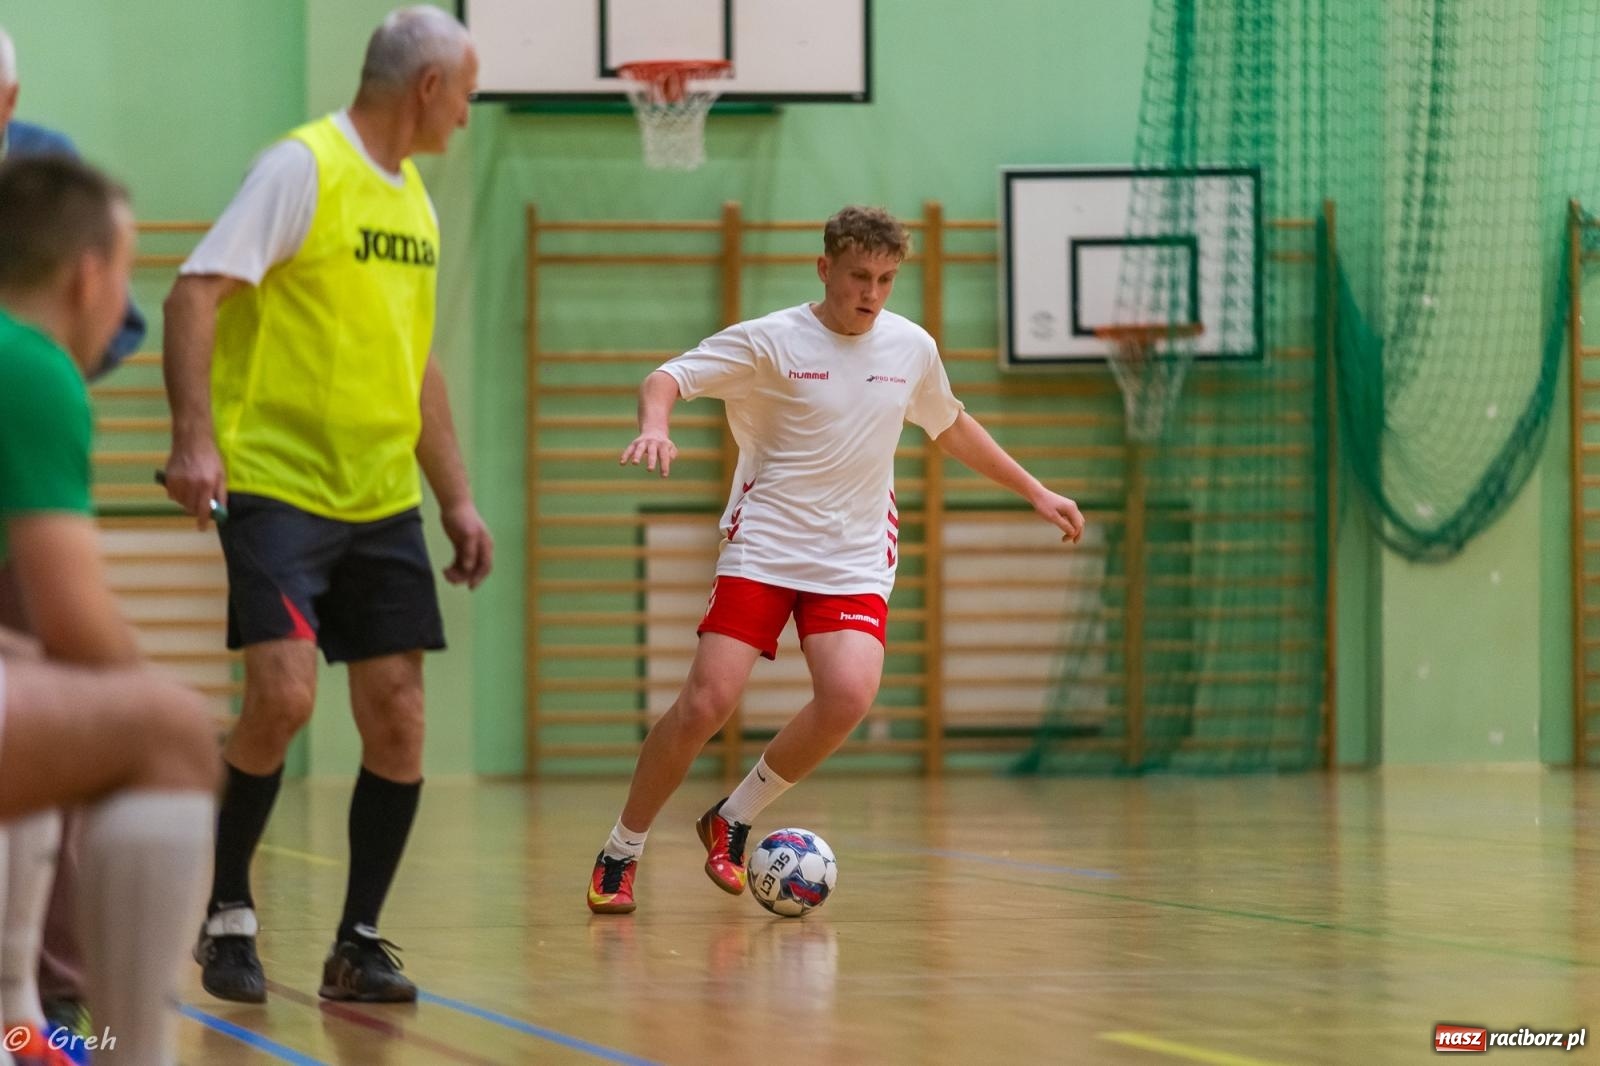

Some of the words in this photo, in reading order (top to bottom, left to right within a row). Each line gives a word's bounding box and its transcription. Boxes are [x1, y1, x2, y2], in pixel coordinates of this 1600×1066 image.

[788, 369, 829, 380] hummel
[840, 611, 880, 627] hummel
[760, 852, 790, 896] SELECT
